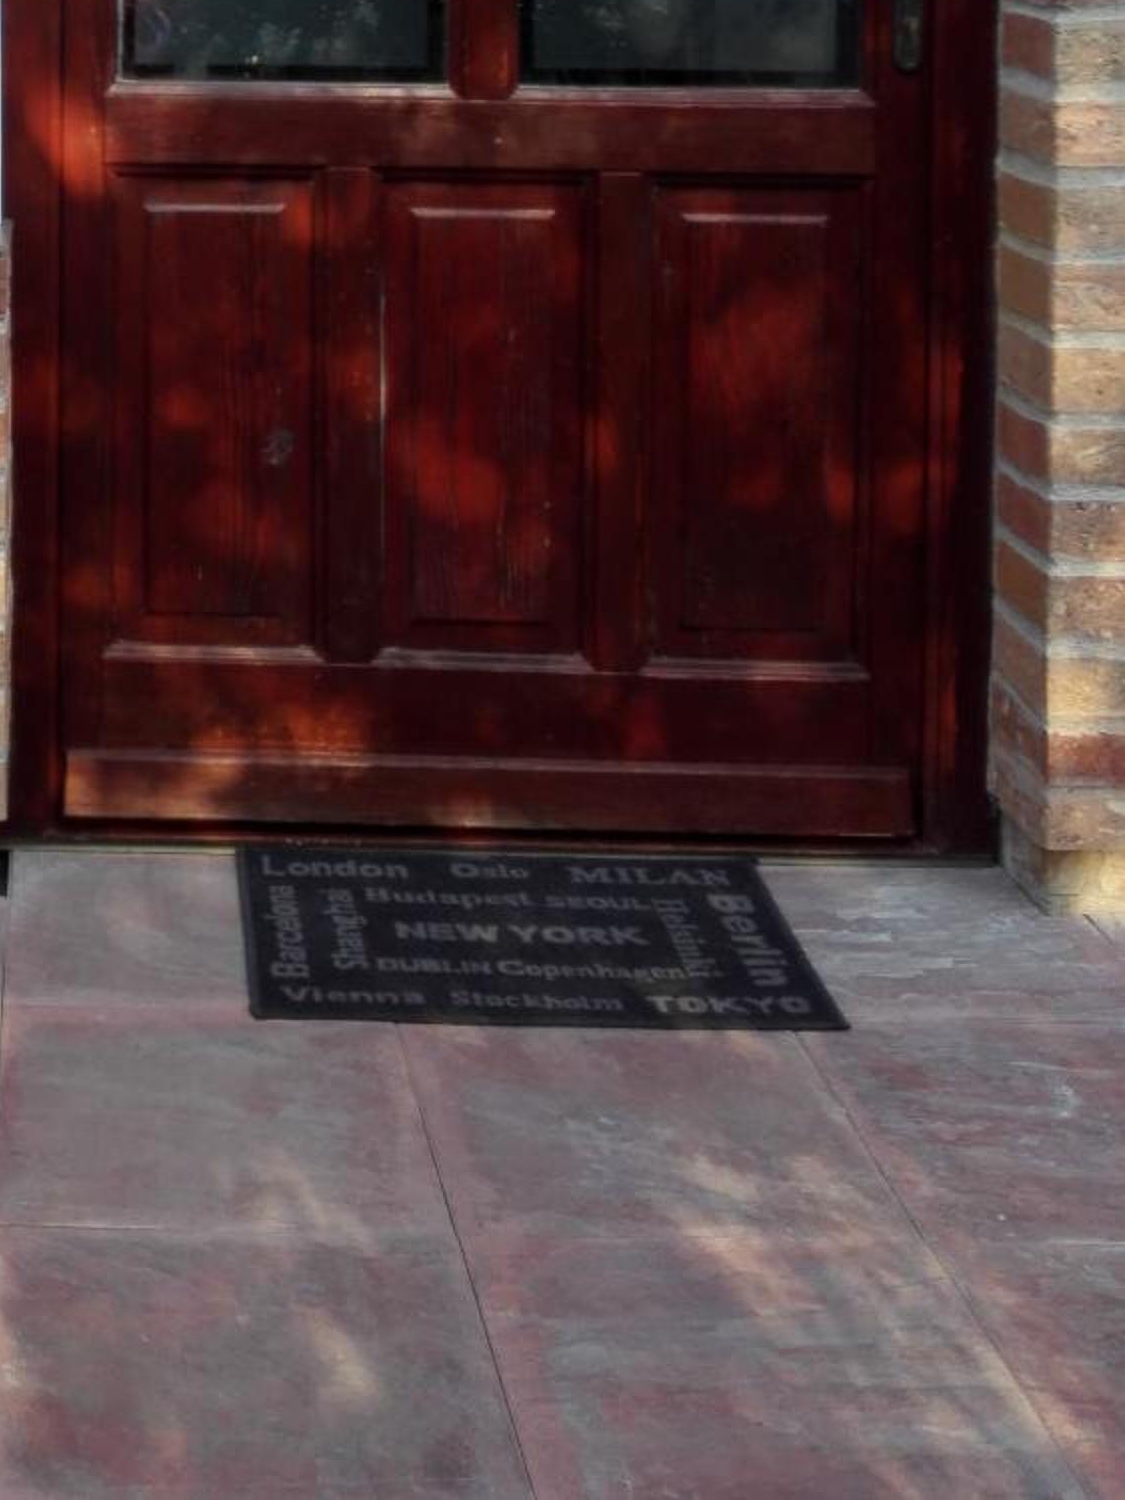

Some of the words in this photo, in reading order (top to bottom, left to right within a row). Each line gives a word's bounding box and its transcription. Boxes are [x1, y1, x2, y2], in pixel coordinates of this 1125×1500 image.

[261, 854, 409, 879] London
[450, 861, 530, 879] Oslo
[568, 866, 731, 886] MILAN
[364, 887, 536, 909] Budapest
[547, 896, 652, 911] SEOUL
[266, 883, 310, 979] Barcelona
[320, 886, 368, 972] Shanghai
[394, 921, 498, 943] NEW
[508, 924, 650, 947] YORK
[707, 893, 789, 987] Berlin
[375, 957, 492, 975] DUBLIN
[496, 959, 690, 984] Copenhagen
[279, 985, 427, 1005] Vienna
[448, 989, 624, 1011] Stockholm
[644, 994, 811, 1014] TOKYO
